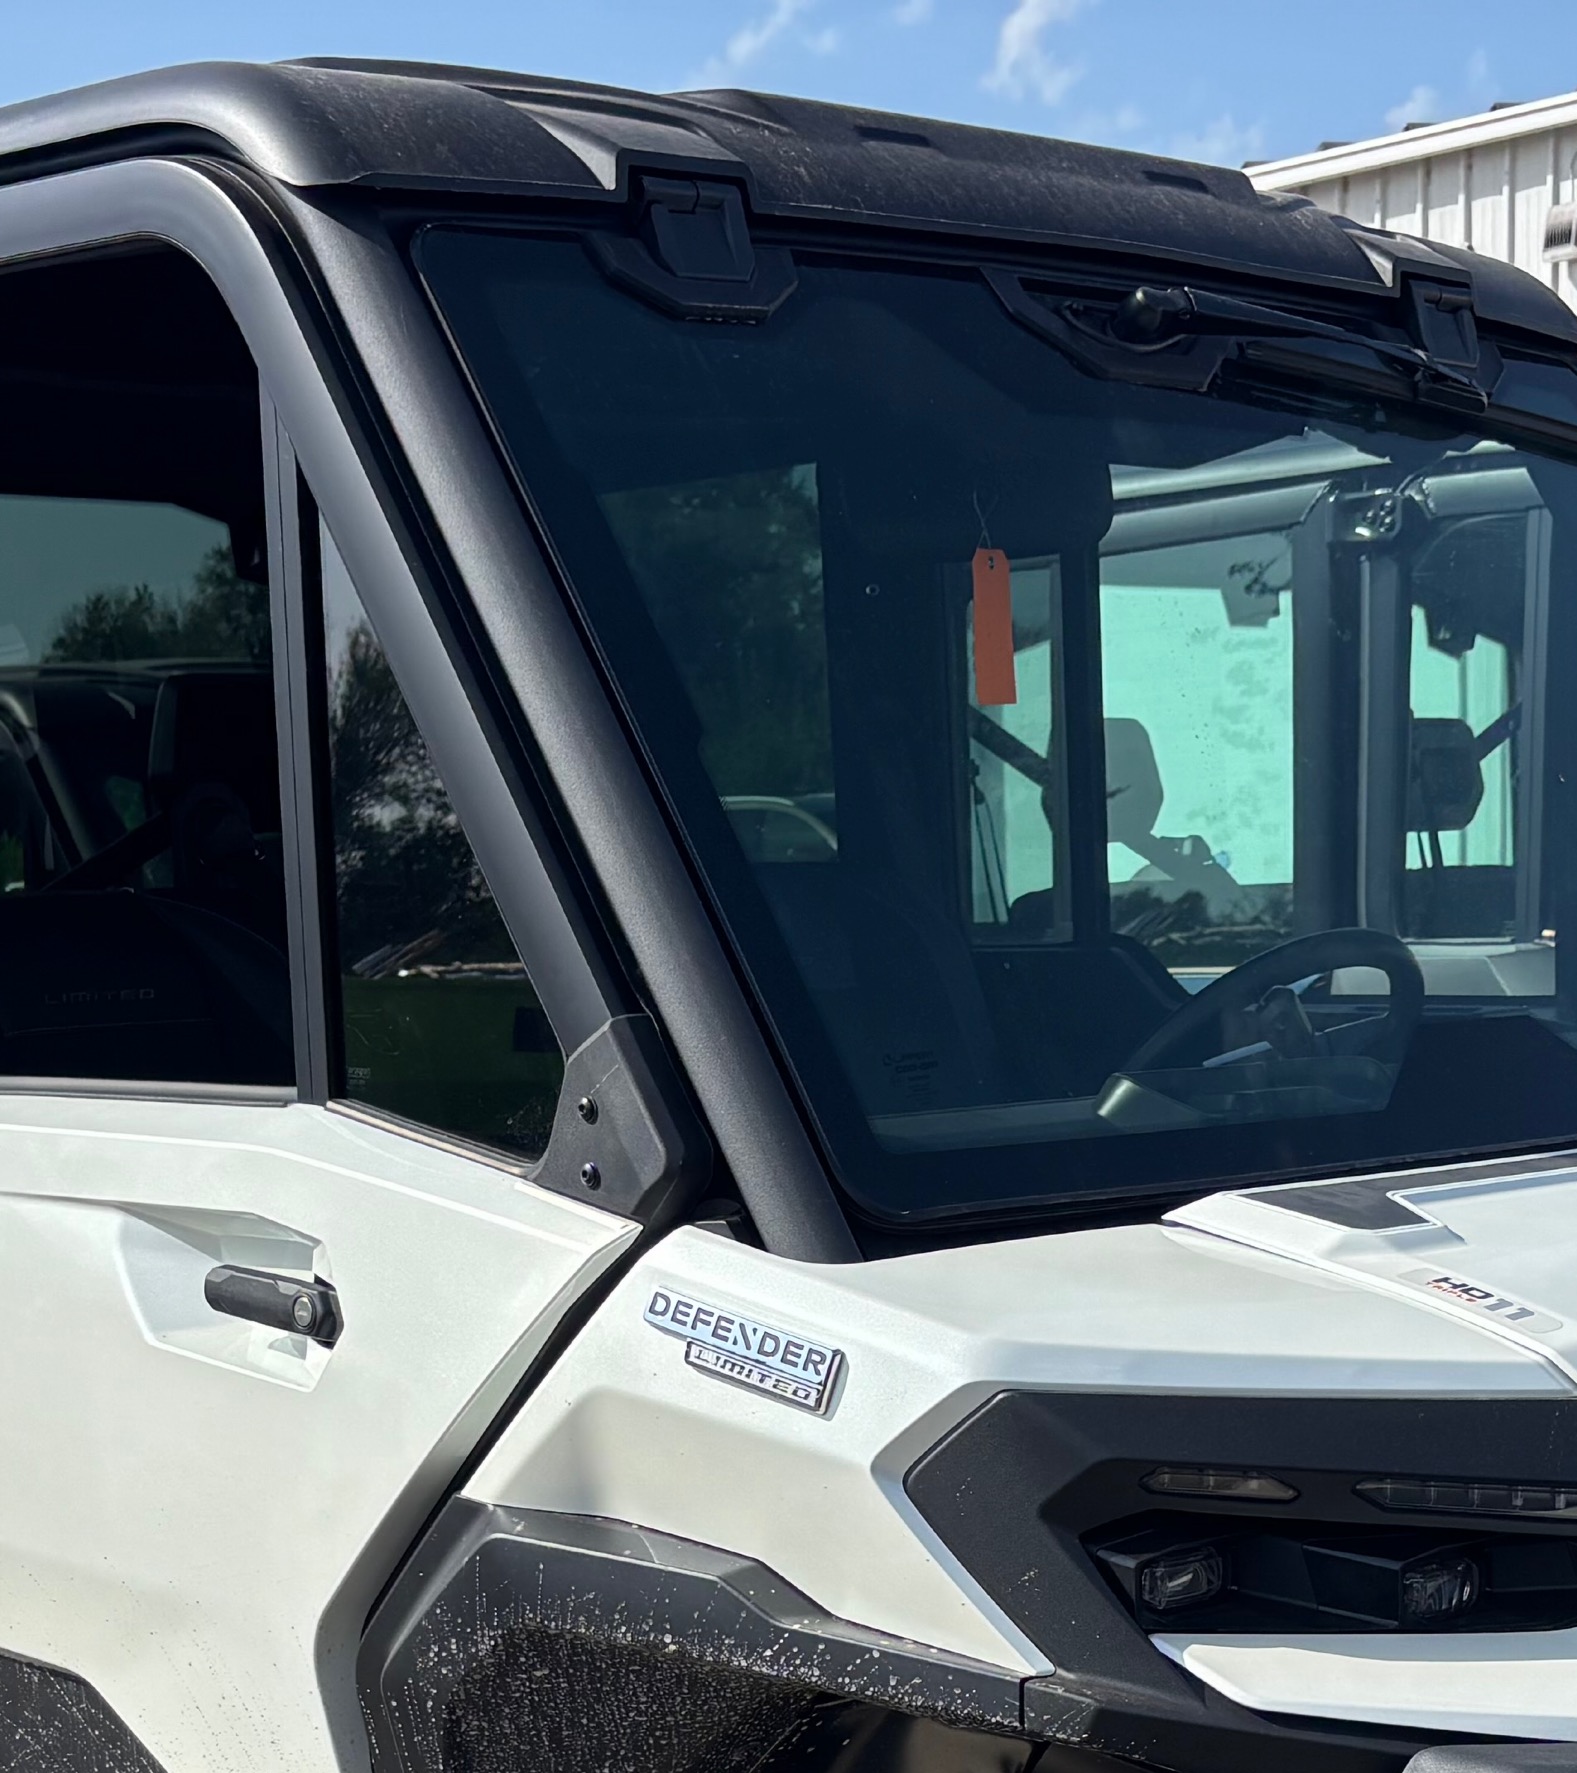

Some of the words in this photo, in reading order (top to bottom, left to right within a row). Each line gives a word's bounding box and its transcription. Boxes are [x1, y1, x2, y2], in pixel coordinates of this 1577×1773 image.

[44, 988, 155, 1005] LIMITED
[648, 1291, 828, 1377] DEFENDER
[693, 1347, 820, 1403] LIMITED
